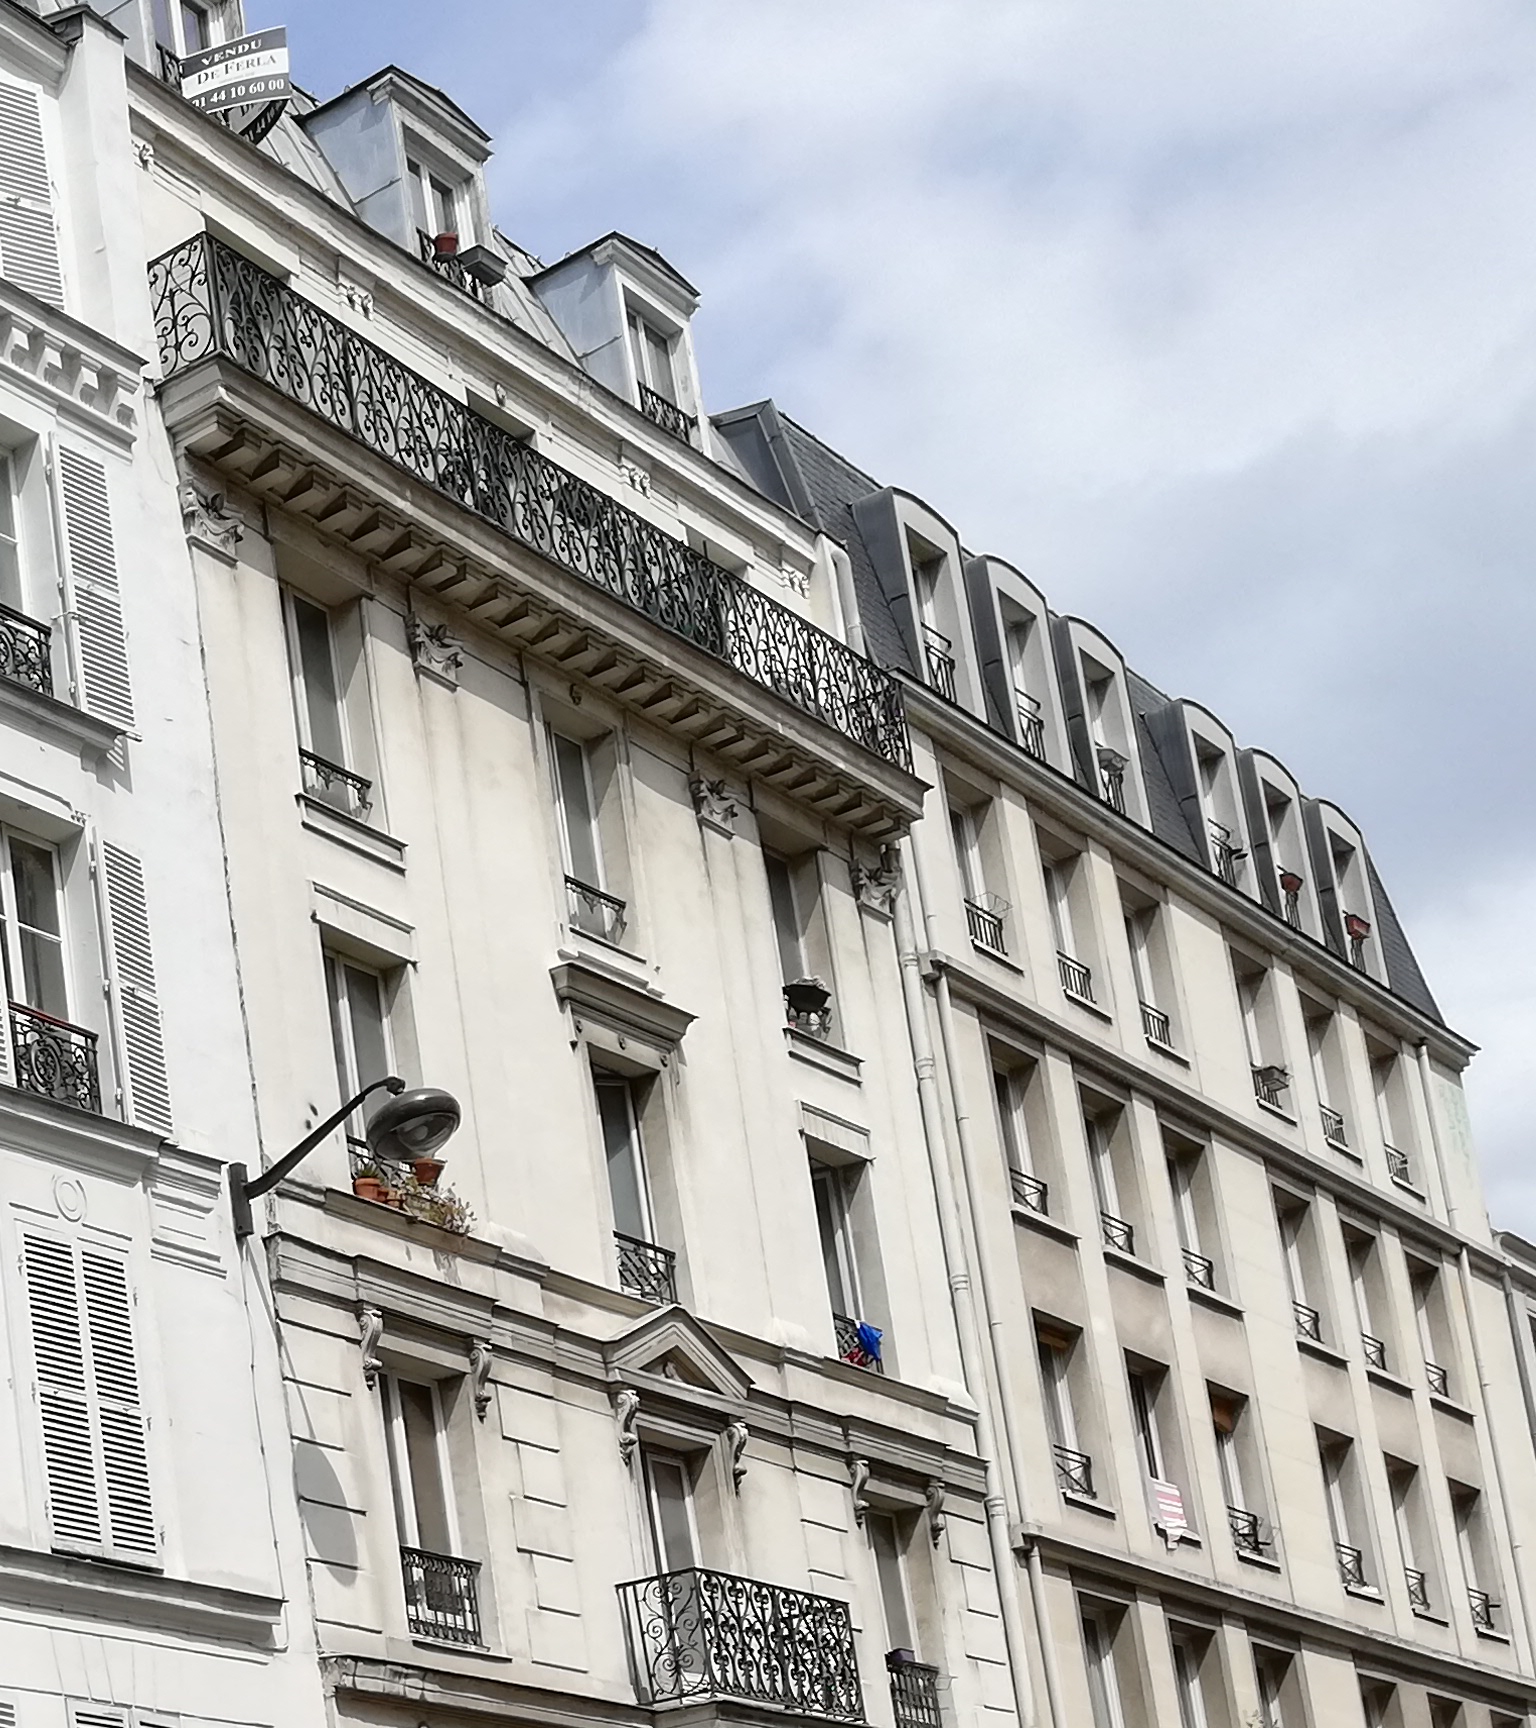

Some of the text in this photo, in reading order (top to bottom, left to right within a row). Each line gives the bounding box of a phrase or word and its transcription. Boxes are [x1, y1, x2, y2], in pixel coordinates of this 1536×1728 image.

[201, 38, 262, 66] VENDU
[210, 90, 226, 103] 44
[230, 85, 246, 99] 10
[249, 81, 265, 94] 60
[268, 78, 285, 91] 00
